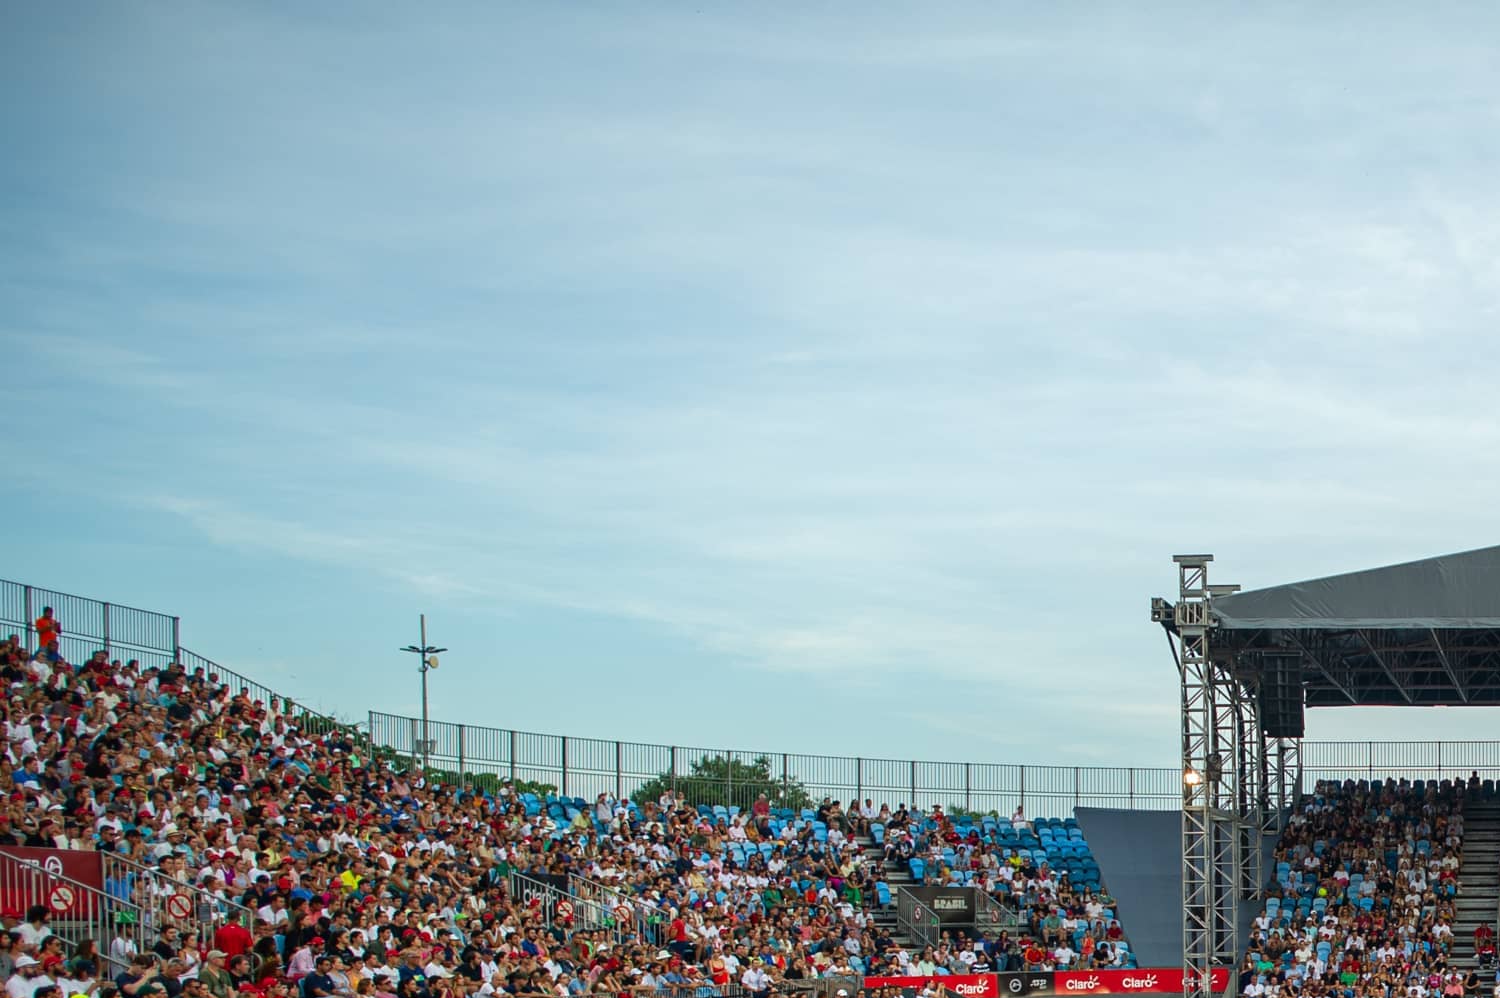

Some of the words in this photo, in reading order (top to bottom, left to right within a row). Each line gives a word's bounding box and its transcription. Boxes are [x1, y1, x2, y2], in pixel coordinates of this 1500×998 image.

[1066, 978, 1094, 990] Claro
[1122, 976, 1152, 988] Claro
[956, 983, 983, 995] Claro
